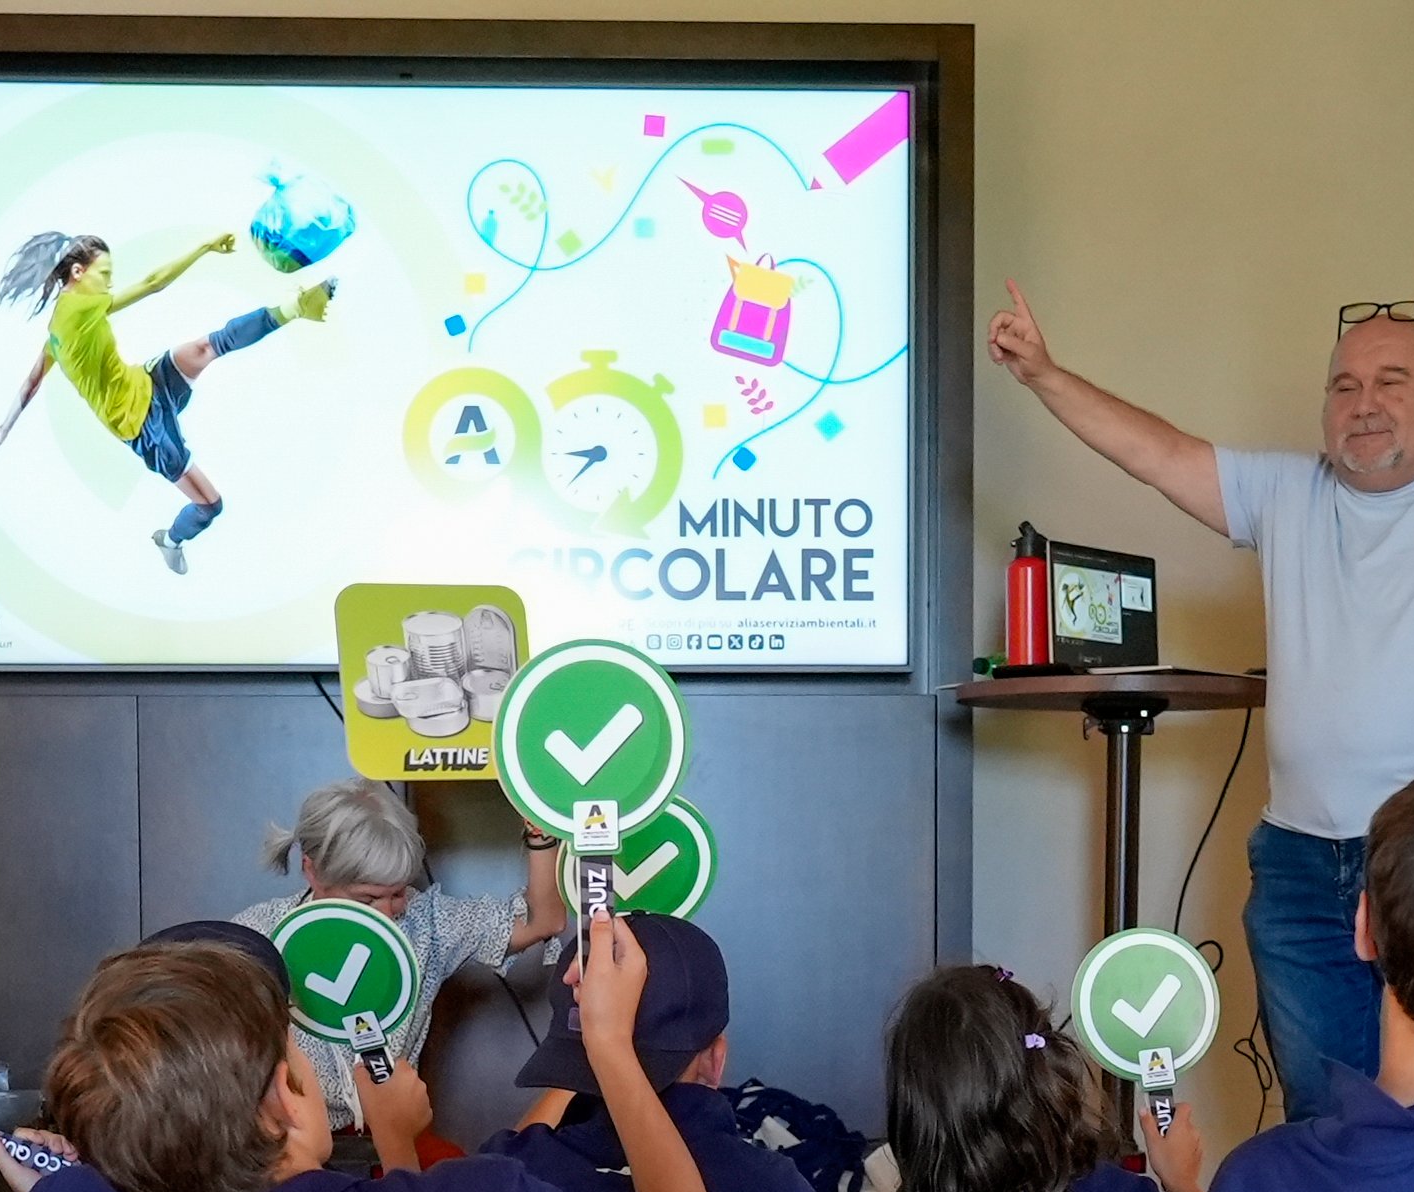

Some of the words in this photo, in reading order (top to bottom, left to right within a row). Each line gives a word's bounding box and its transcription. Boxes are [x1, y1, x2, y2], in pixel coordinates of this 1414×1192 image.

[679, 498, 874, 538] MINUTO
[737, 617, 877, 629] aliaserviziambientali.it
[405, 747, 490, 771] LATTINE
